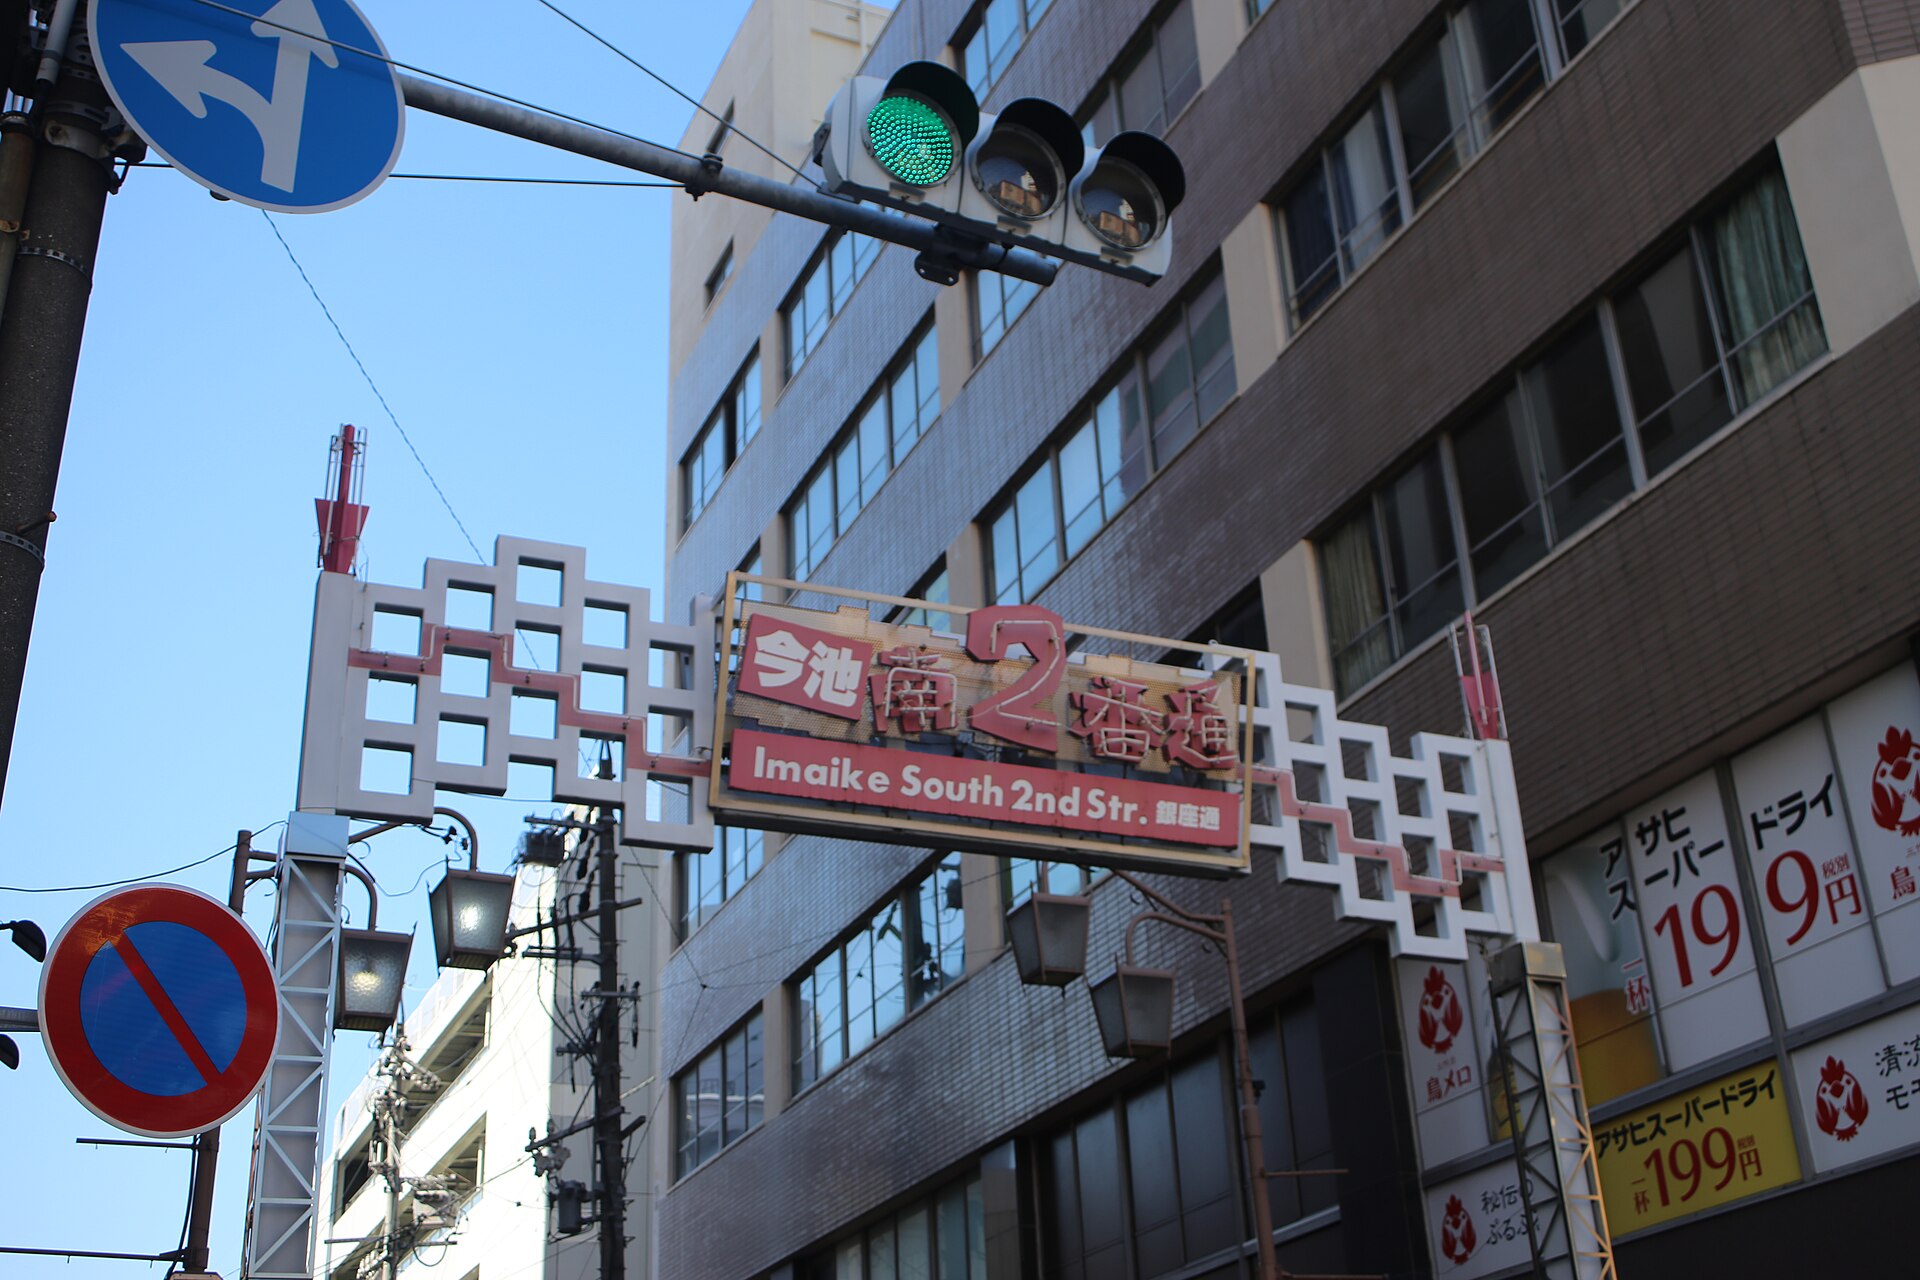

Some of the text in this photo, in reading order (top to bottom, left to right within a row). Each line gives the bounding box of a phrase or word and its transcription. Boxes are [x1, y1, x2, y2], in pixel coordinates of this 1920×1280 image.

[753, 745, 1221, 832] Imaike South 2nd Str. 銀座通
[1426, 1065, 1471, 1104] 鳥メロ
[1595, 1069, 1775, 1159] アサヒスーパードライ
